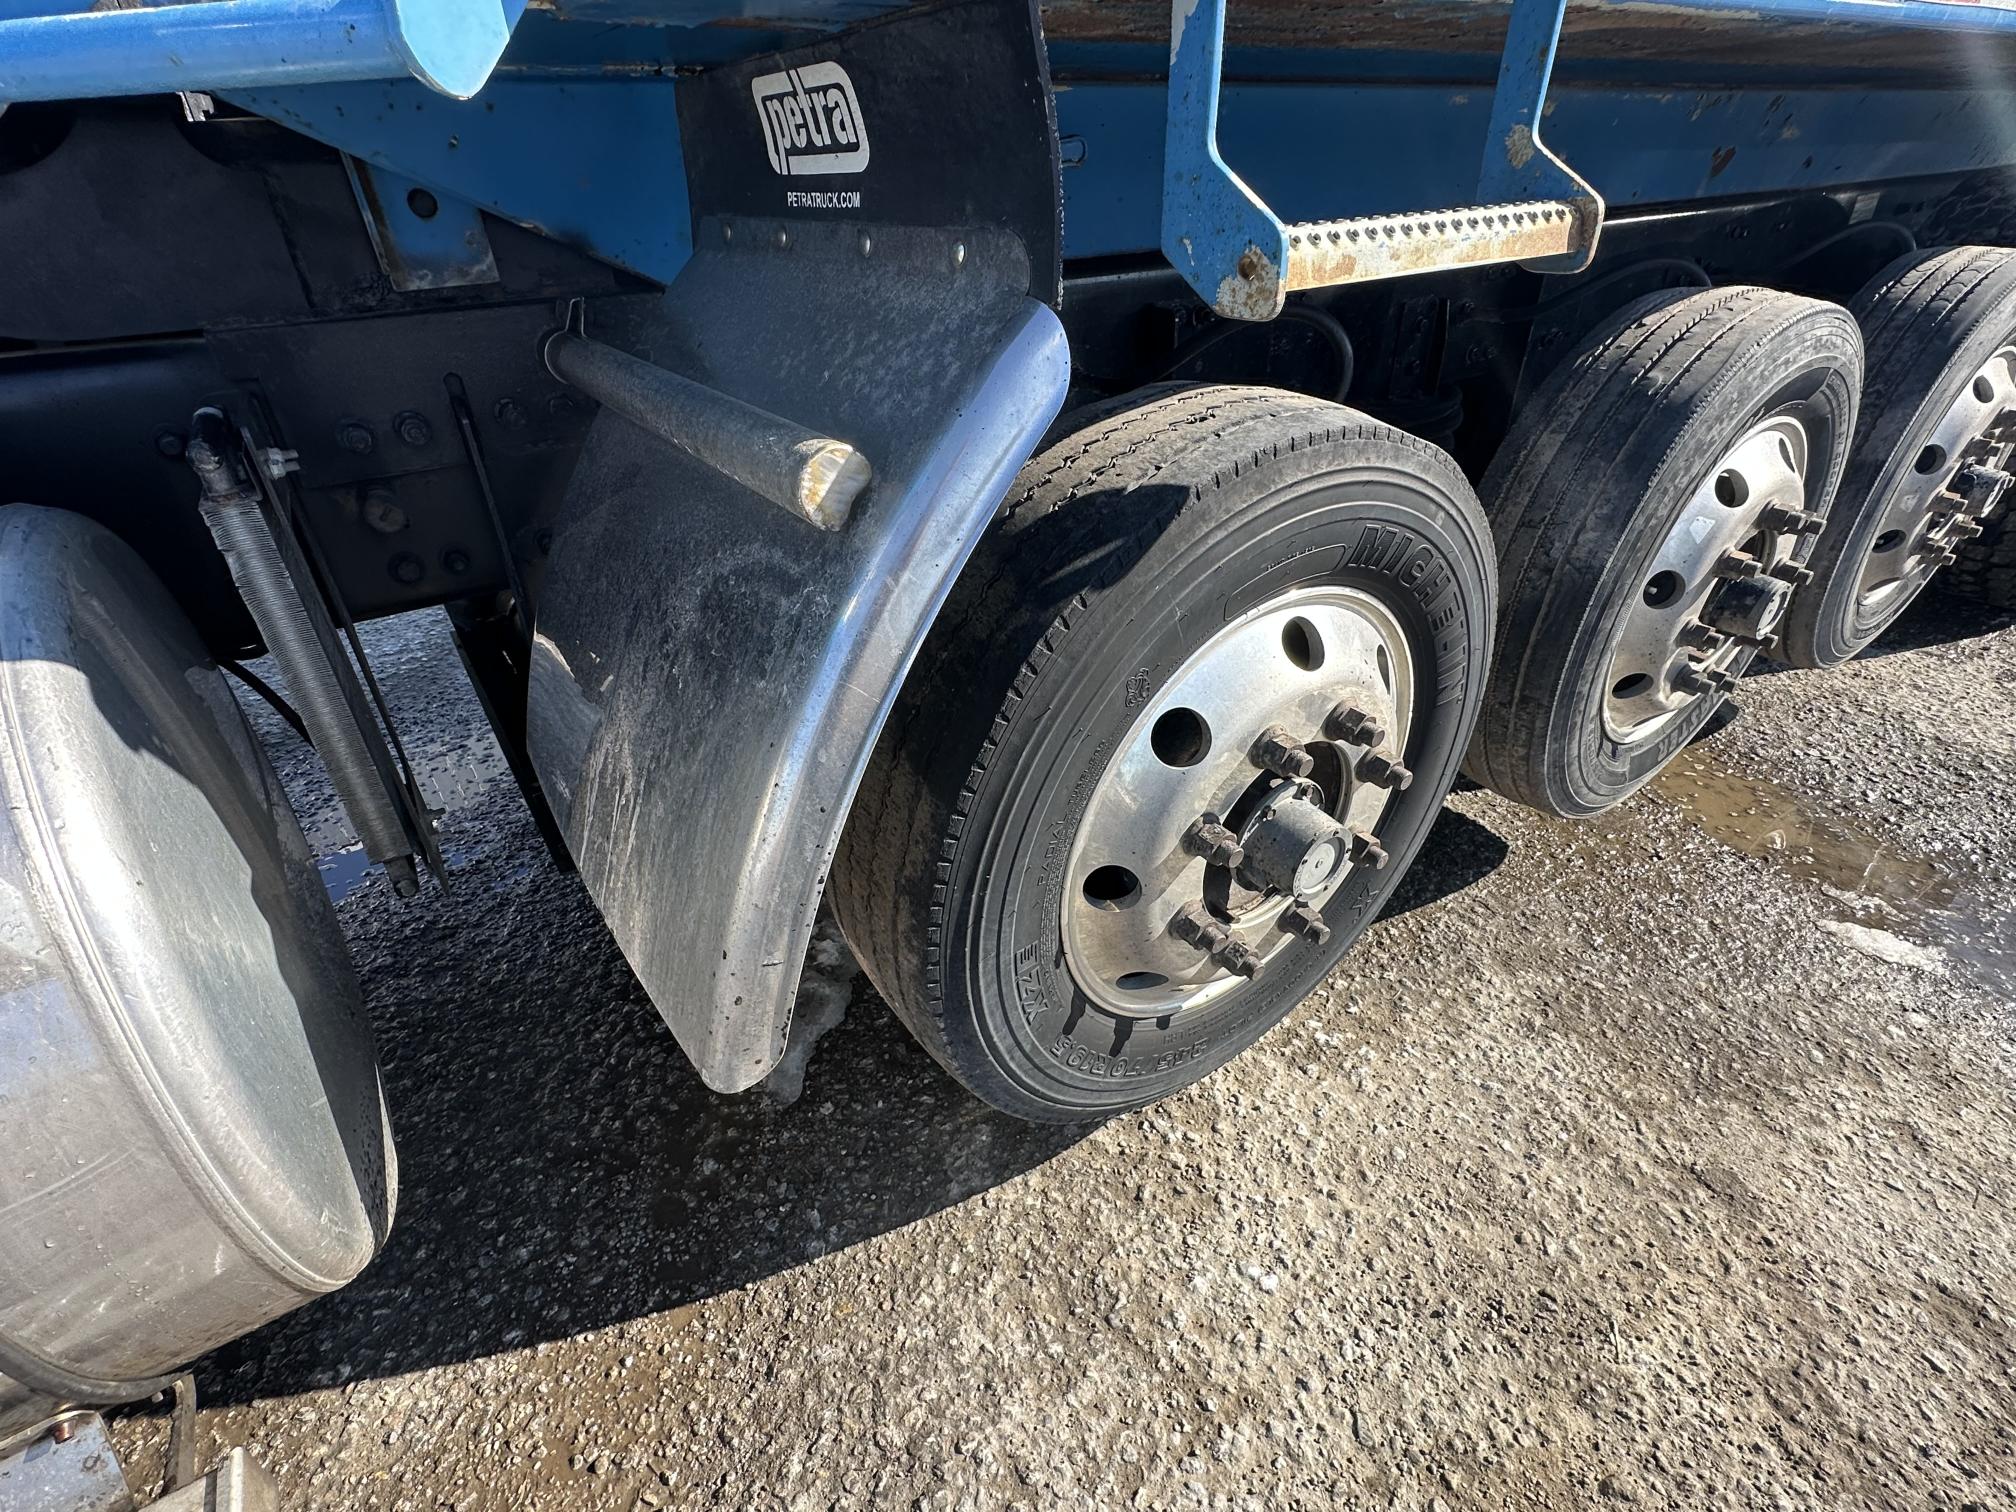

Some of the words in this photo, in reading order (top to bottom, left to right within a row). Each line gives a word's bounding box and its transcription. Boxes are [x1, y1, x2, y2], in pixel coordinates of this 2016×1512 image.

[766, 69, 858, 175] petra
[787, 191, 861, 208] PETRATRUCK.COM
[1347, 523, 1468, 707] MICHELIN
